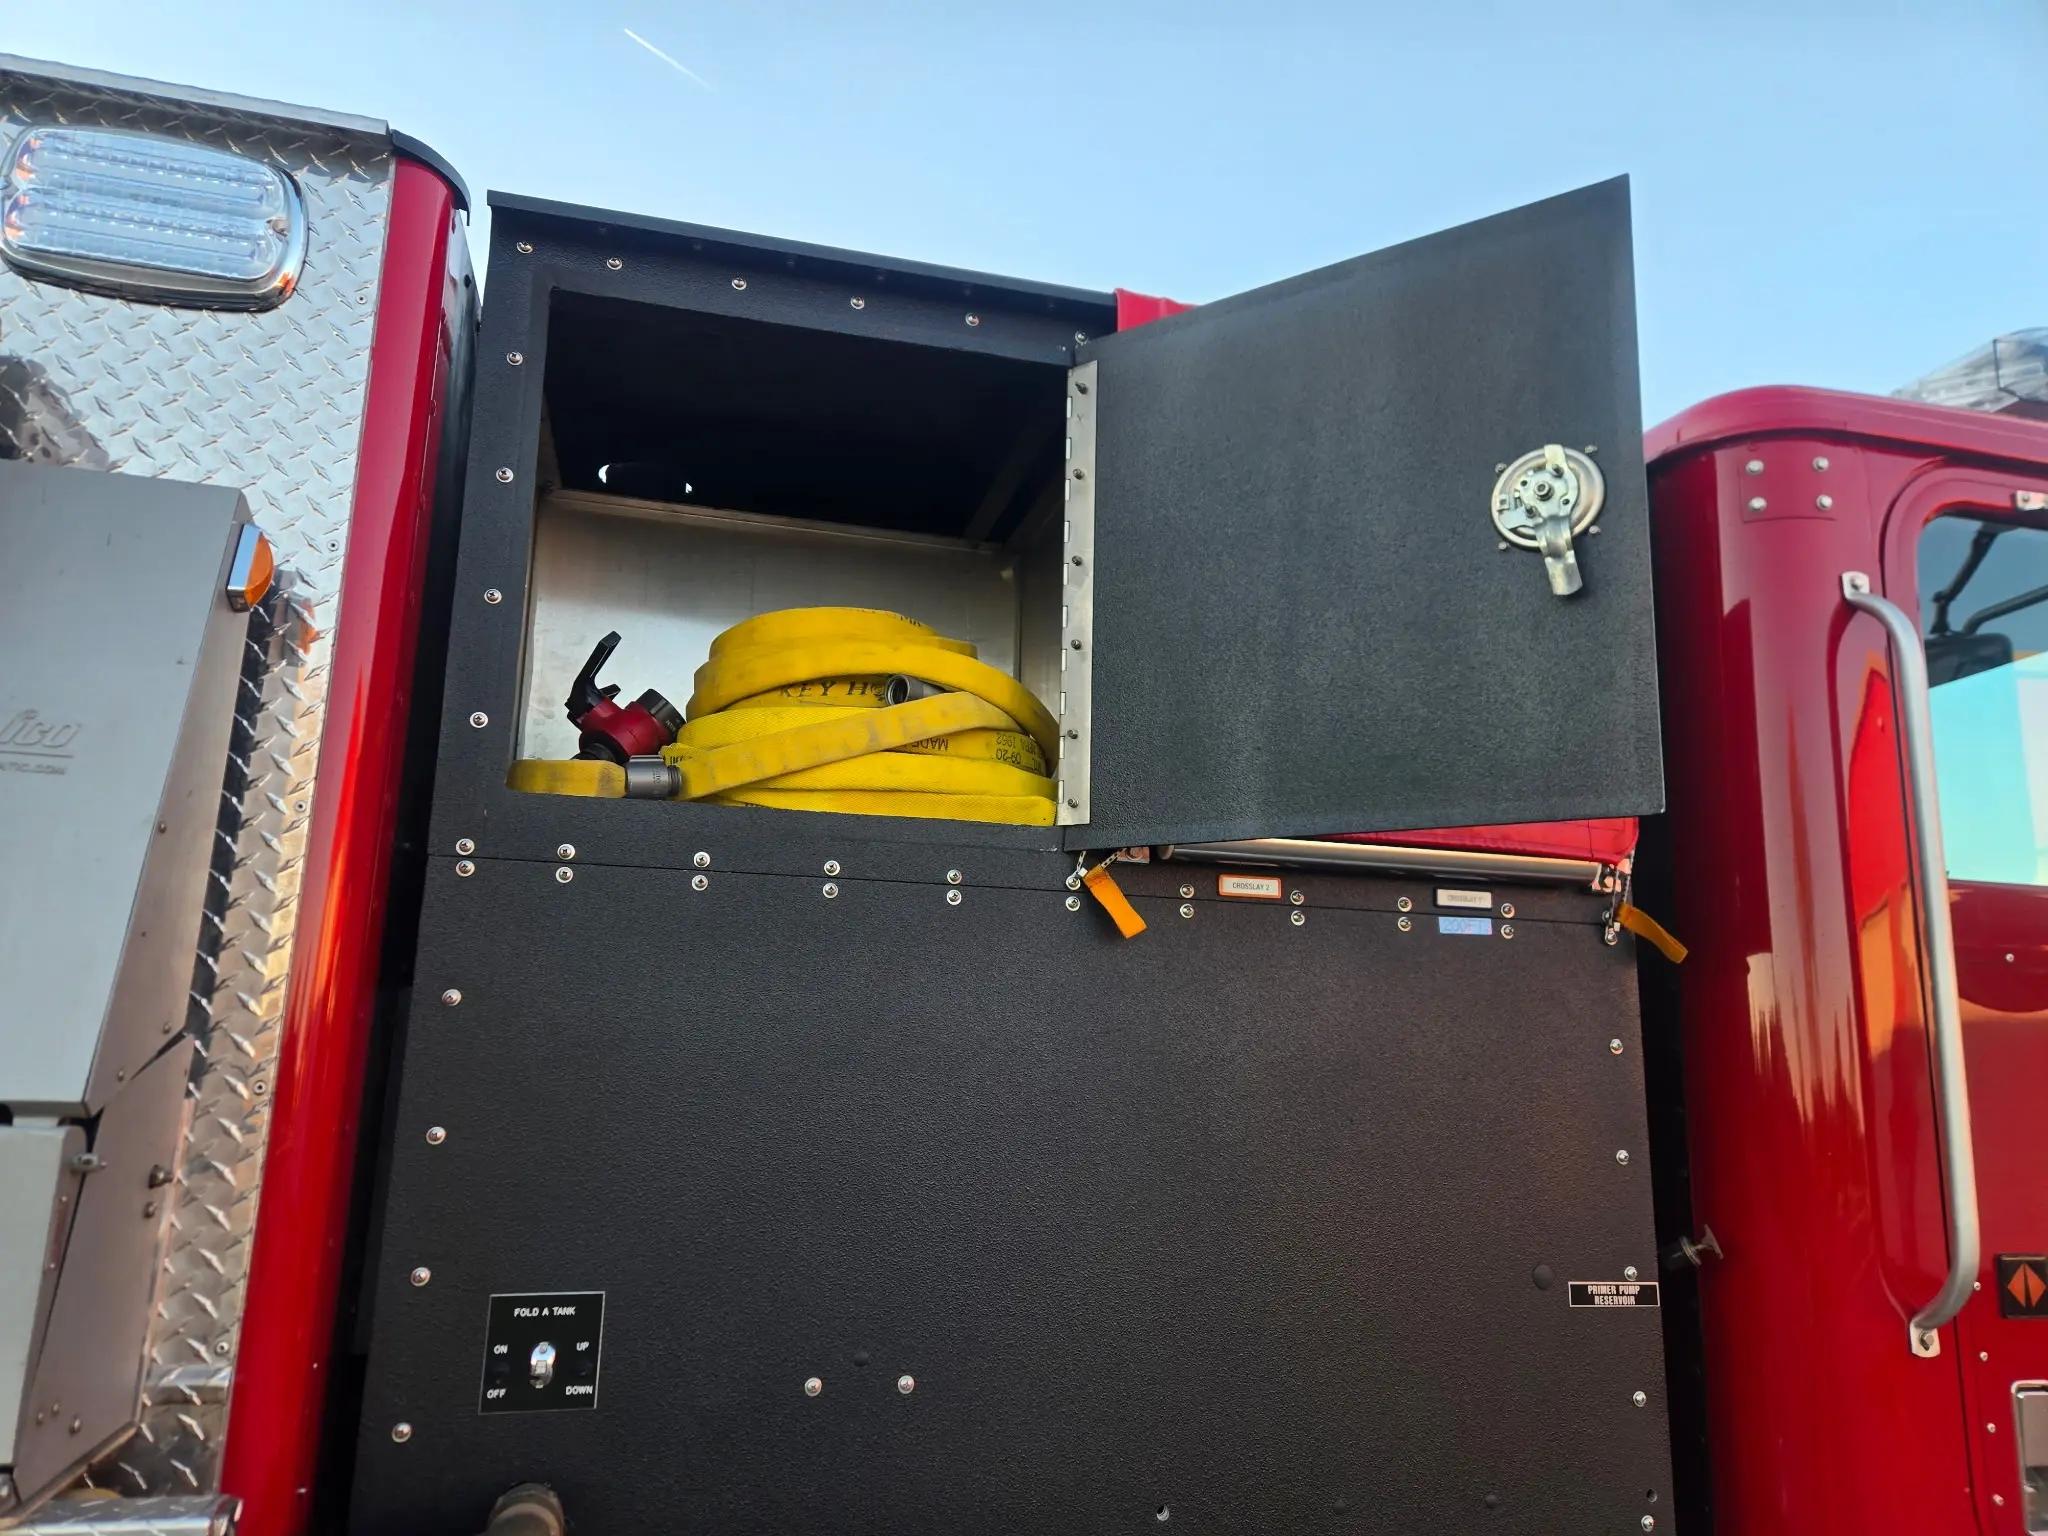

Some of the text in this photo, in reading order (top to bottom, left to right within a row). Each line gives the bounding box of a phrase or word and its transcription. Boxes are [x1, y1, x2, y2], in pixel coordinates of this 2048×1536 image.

[1232, 882, 1264, 891] CROSSLAY
[1587, 1285, 1641, 1295] PRIMER PUMP
[1594, 1295, 1636, 1305] RESERVOIR
[514, 1306, 576, 1317] FOLD A TANK
[493, 1344, 509, 1354] ON
[576, 1341, 590, 1351] UP
[486, 1388, 507, 1399] OFF
[565, 1385, 593, 1395] DOWN
